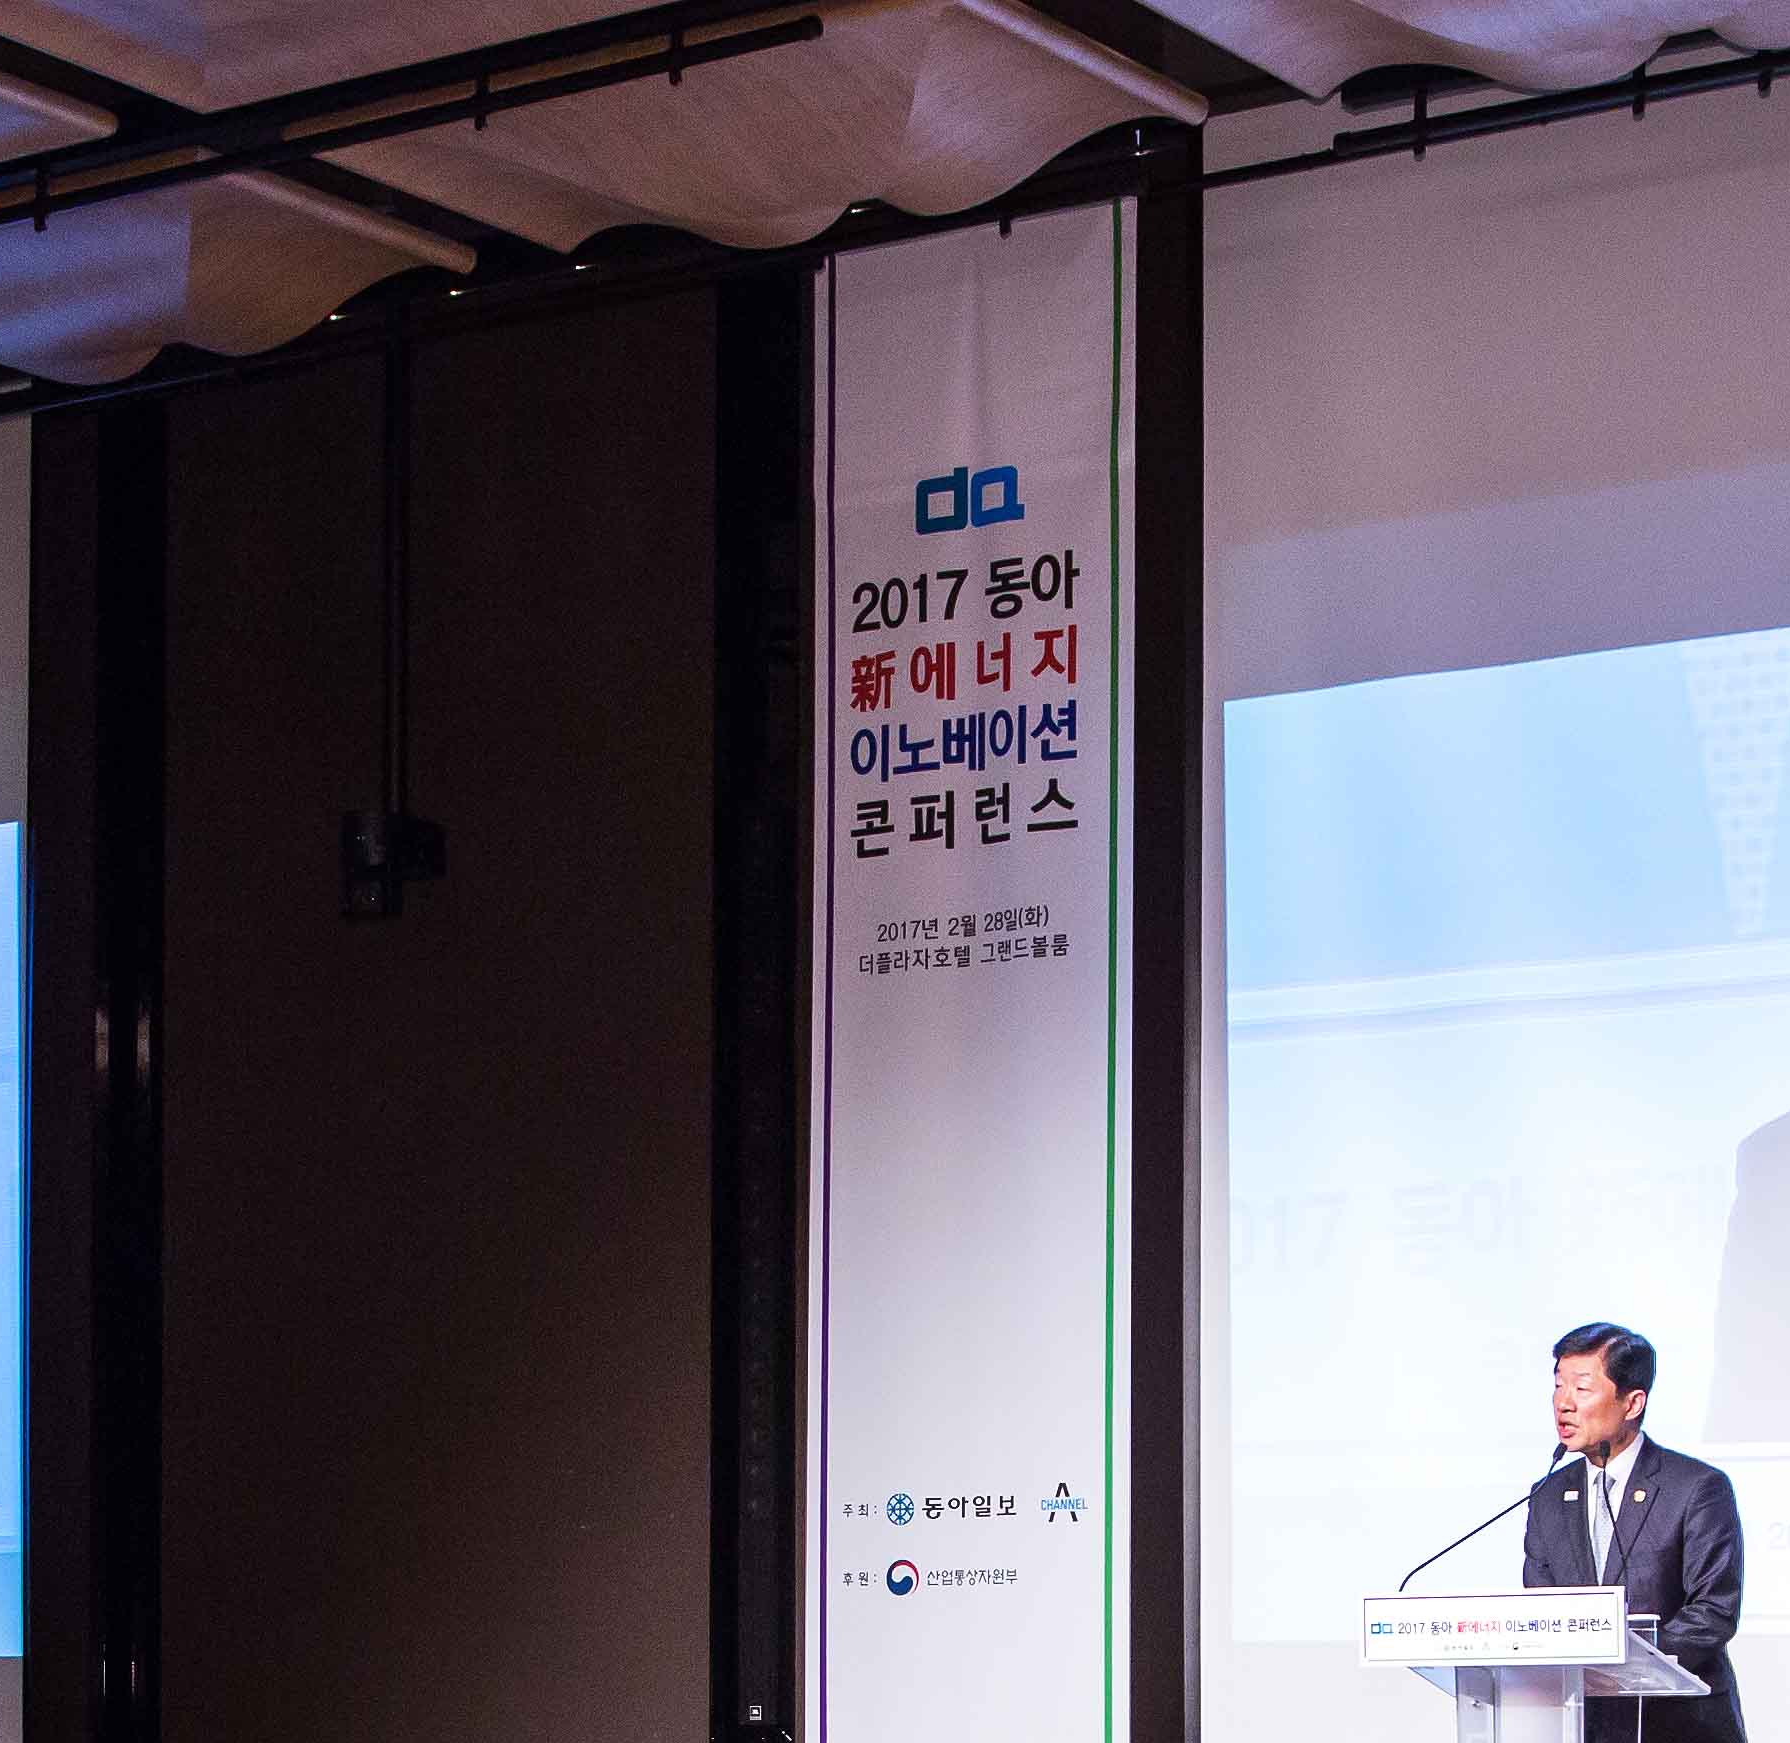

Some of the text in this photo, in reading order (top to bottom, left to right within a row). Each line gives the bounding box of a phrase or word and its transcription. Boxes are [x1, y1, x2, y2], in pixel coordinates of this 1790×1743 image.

[852, 549, 1079, 633] 2017 동아
[850, 699, 1078, 782] 이노베이션
[850, 777, 1078, 858] 콘퍼런스
[877, 905, 1049, 944] 2017년 2월 28일(화)
[859, 934, 1070, 976] 더플라자호텔 그랜드볼룸
[921, 1495, 1018, 1520] 동아일보
[1041, 1498, 1088, 1510] CHANNEL
[926, 1568, 1018, 1587] 산업통상자원부
[1397, 1621, 1426, 1635] 2017
[1430, 1621, 1453, 1636] 동아
[1506, 1619, 1562, 1633] 이노베이션
[1566, 1618, 1613, 1633] 콘퍼런스
